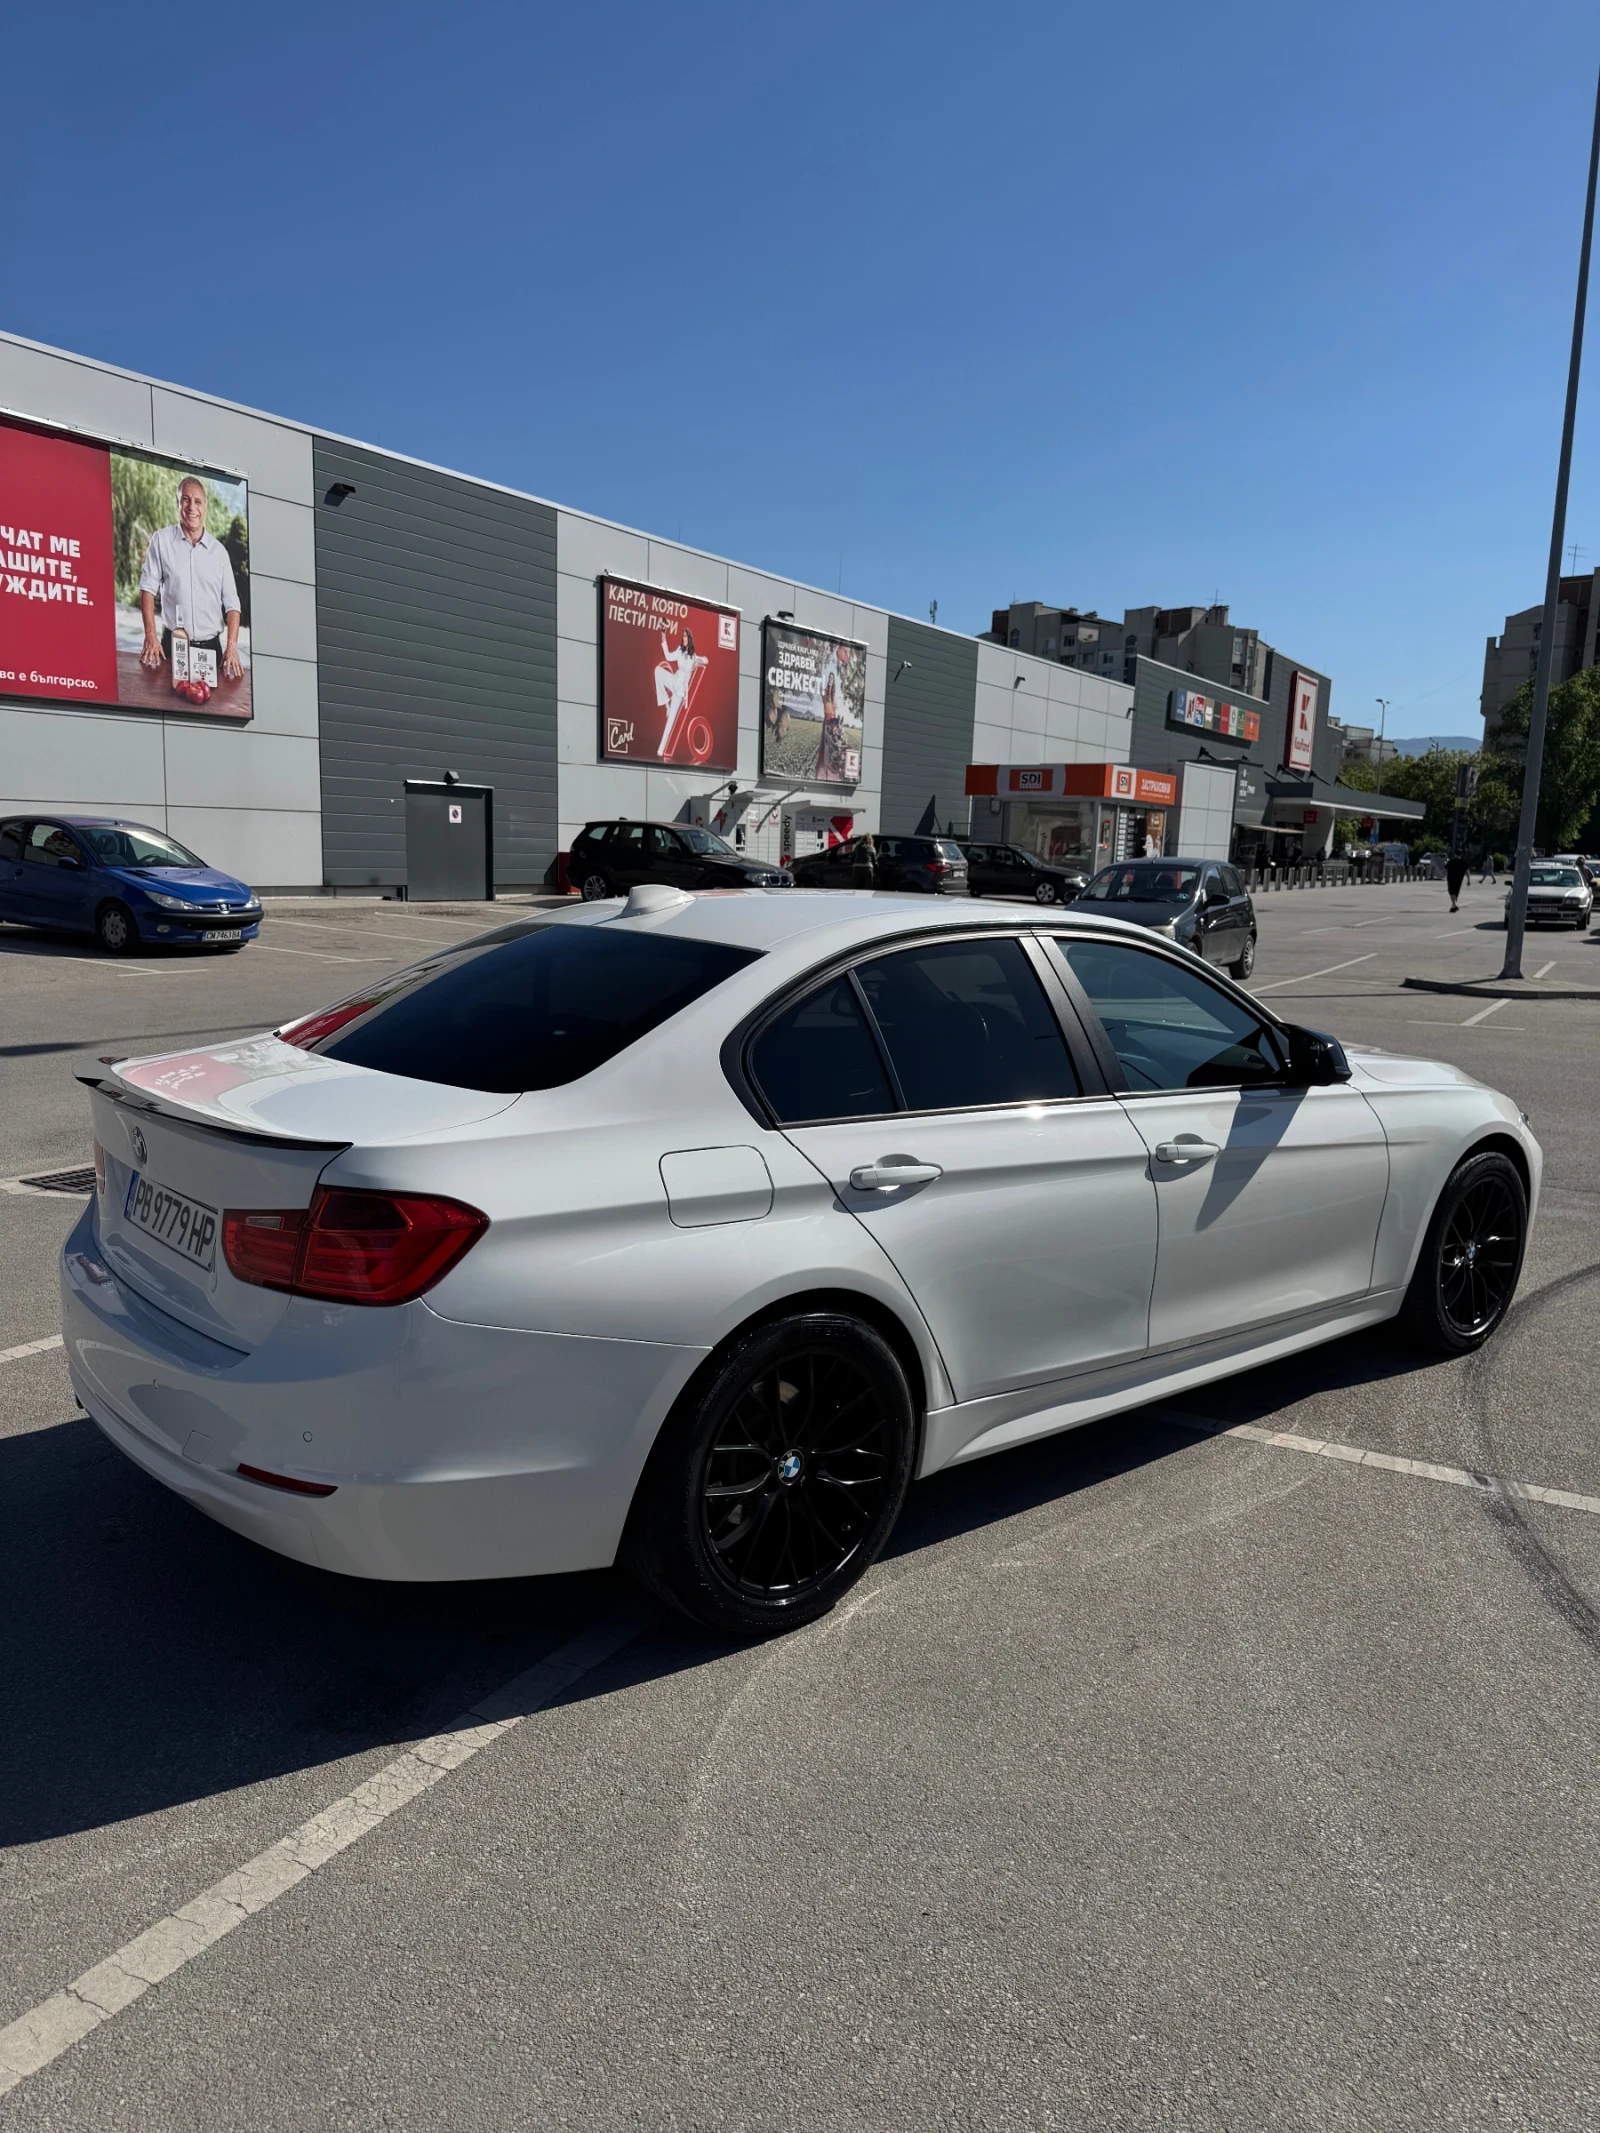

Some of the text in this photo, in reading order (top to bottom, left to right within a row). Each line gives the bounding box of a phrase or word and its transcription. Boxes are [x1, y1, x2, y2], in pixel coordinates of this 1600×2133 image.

[0, 525, 80, 558] ЧАТ МЕ
[0, 573, 94, 606] ЖДИТЕ.
[608, 584, 688, 619] КАРТА, КОЯТО
[608, 604, 646, 628] ПЕСТИ
[778, 651, 817, 673] ЗДРАВЕЙ,
[30, 670, 98, 689] българско.
[768, 666, 827, 696] СВЕЖЕСТ!
[610, 722, 634, 748] Card
[1021, 773, 1041, 785] SDI
[782, 814, 793, 852] speedy
